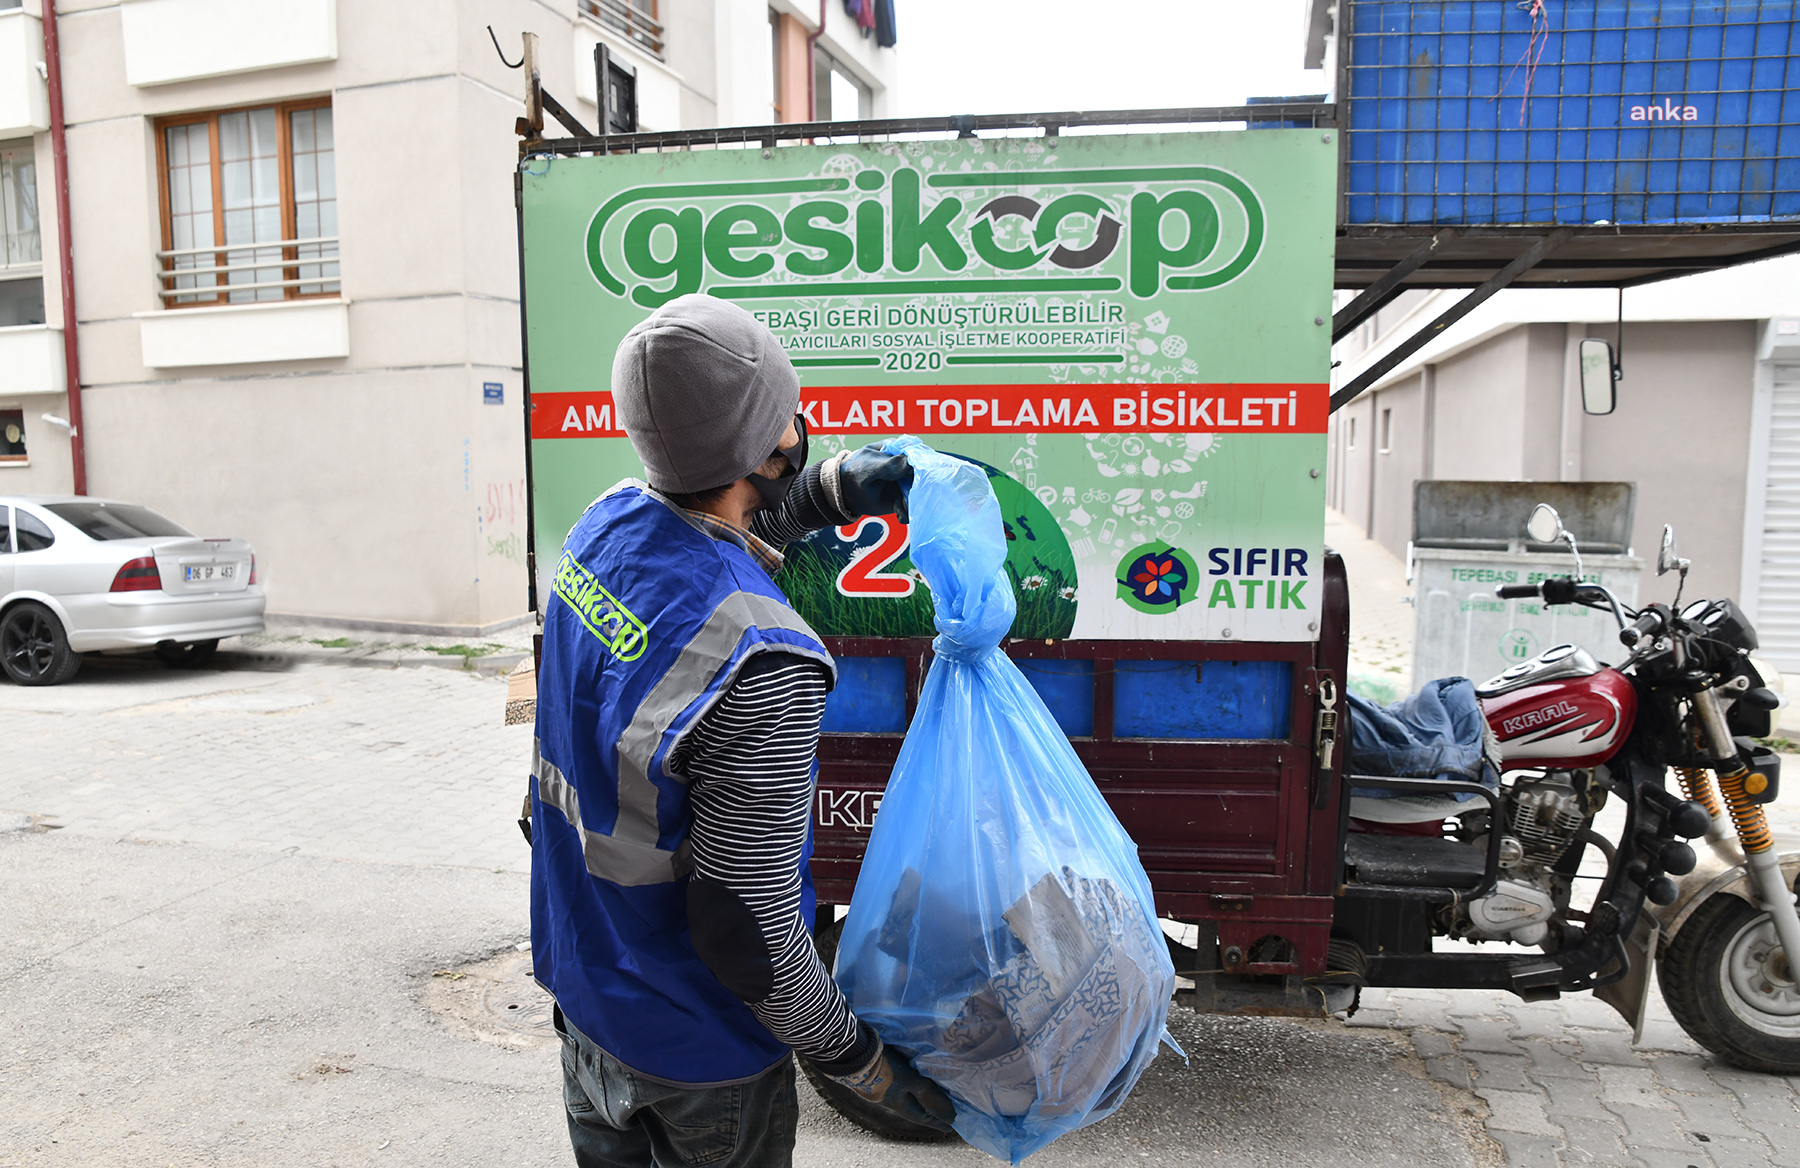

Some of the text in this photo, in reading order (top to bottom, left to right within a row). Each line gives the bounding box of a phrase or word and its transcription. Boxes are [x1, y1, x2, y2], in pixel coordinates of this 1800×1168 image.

[623, 167, 1220, 308] gesikoop
[754, 302, 1124, 332] EBAŞI GERİ DÖNÜŞTÜRÜLEBİLİR
[780, 329, 1126, 350] LAYICILARI SOSYAL İŞLETME KOOPERATİFİ
[885, 352, 941, 371] 2020
[796, 399, 906, 428] KLARI
[916, 398, 1100, 427] TOPLAMA
[1113, 390, 1297, 427] BİSİKLETİ
[1208, 547, 1309, 576] SIFIR
[1207, 579, 1308, 610] ATIK
[1503, 701, 1579, 734] KRAL
